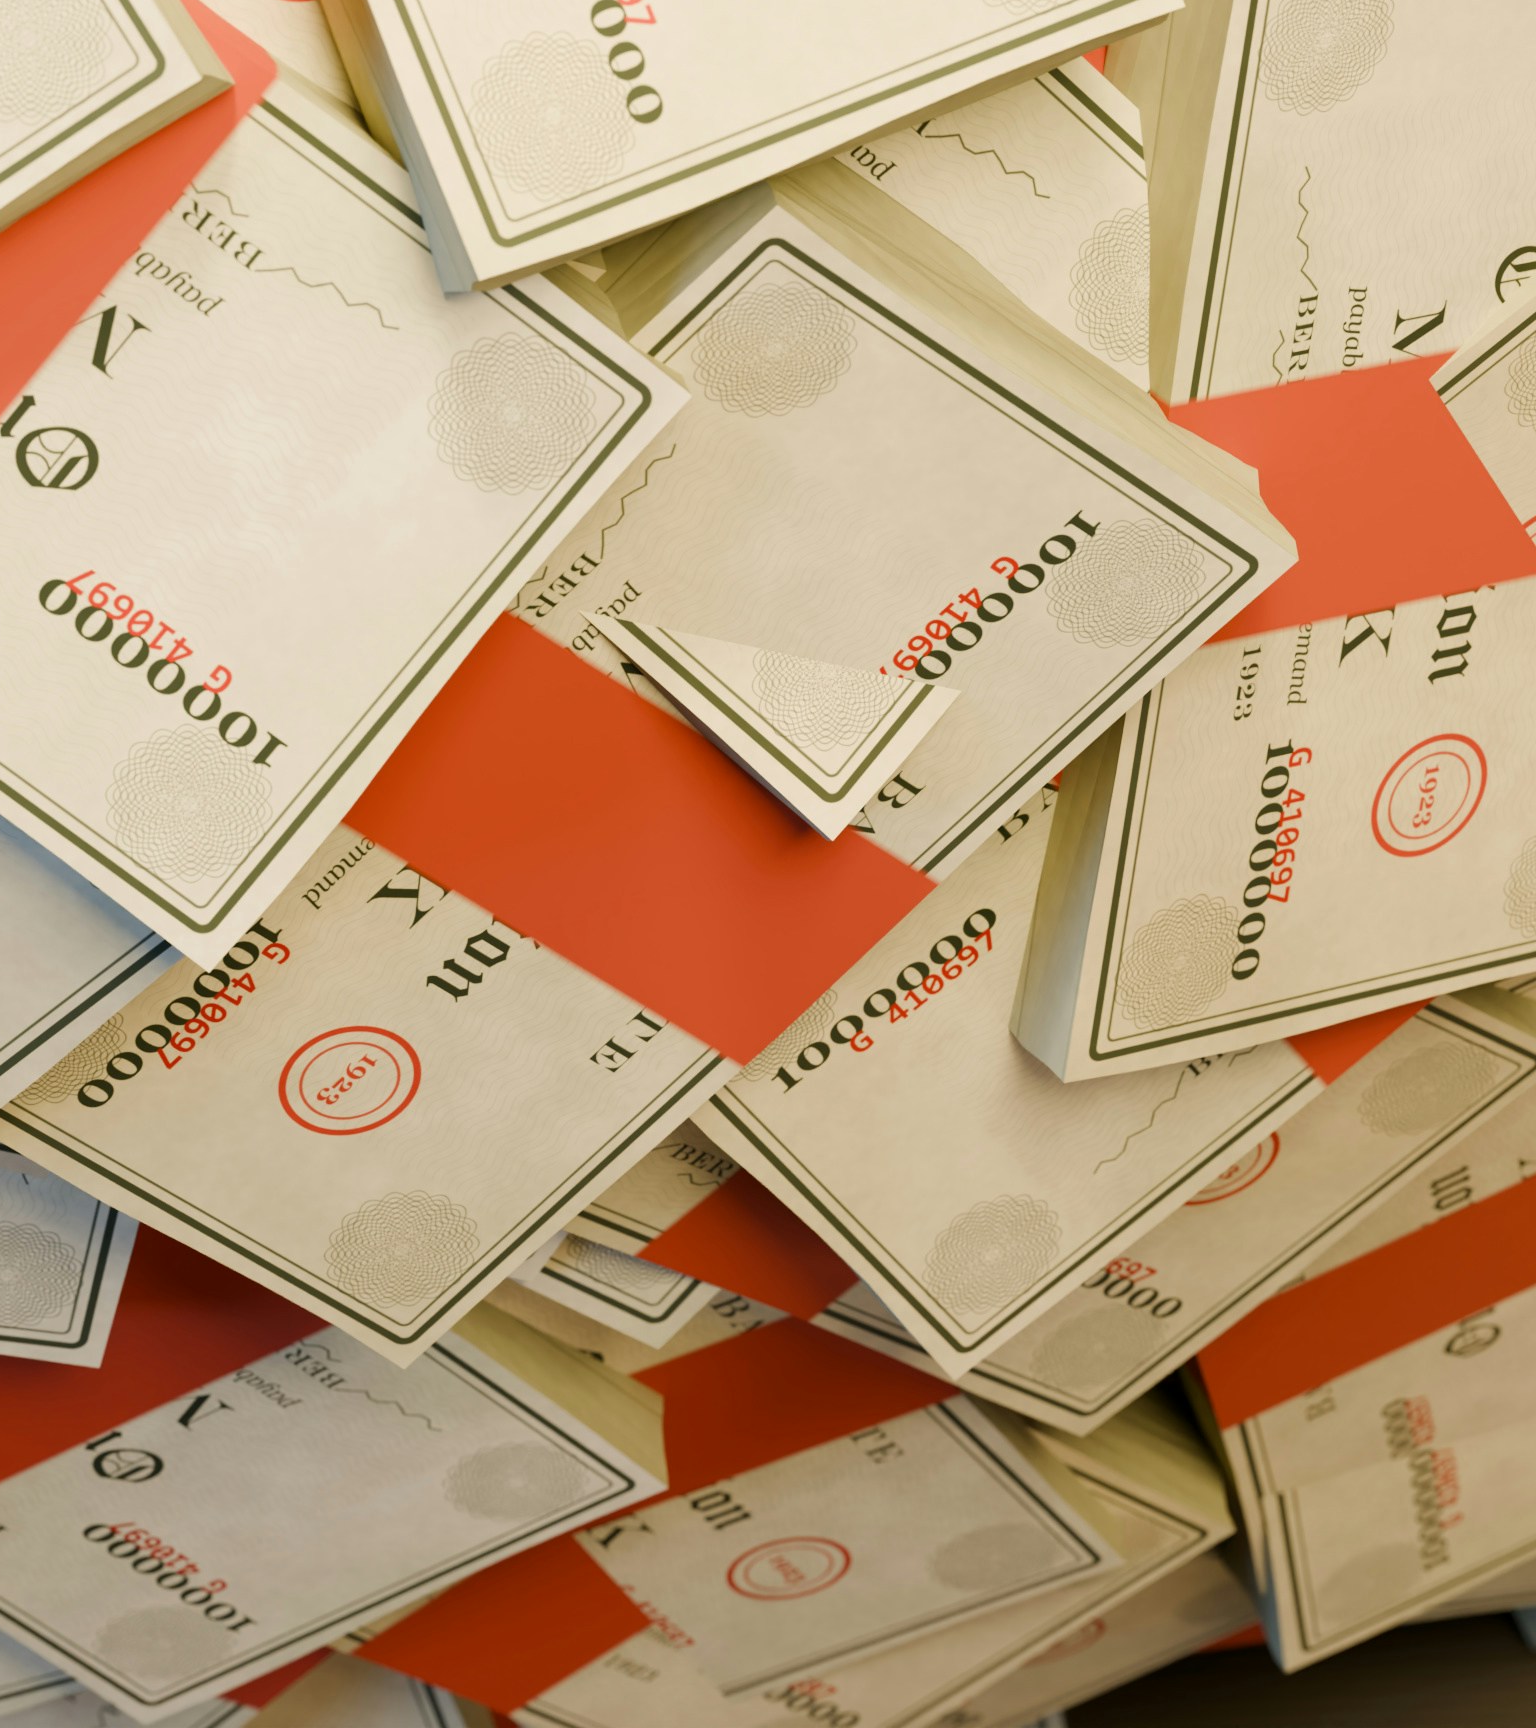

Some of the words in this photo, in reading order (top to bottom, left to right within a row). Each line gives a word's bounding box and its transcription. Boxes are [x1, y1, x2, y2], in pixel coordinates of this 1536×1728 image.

[1341, 286, 1369, 369] payab
[989, 555, 1021, 581] G
[64, 569, 194, 665] 410697
[878, 586, 984, 676] 41069
[37, 578, 289, 769] 1000000
[201, 664, 234, 696] G
[1232, 646, 1263, 722] 1923
[1286, 746, 1314, 769] G
[1411, 765, 1441, 830] 1923
[1229, 737, 1295, 982] 1000000
[1264, 787, 1307, 904] 410697
[260, 941, 292, 966] G
[848, 1028, 875, 1054] G
[888, 927, 994, 1025] 410697
[155, 971, 257, 1071] 410697
[770, 907, 998, 1093] 1000000
[315, 1043, 380, 1118] 1923
[82, 1523, 254, 1632] 1000000
